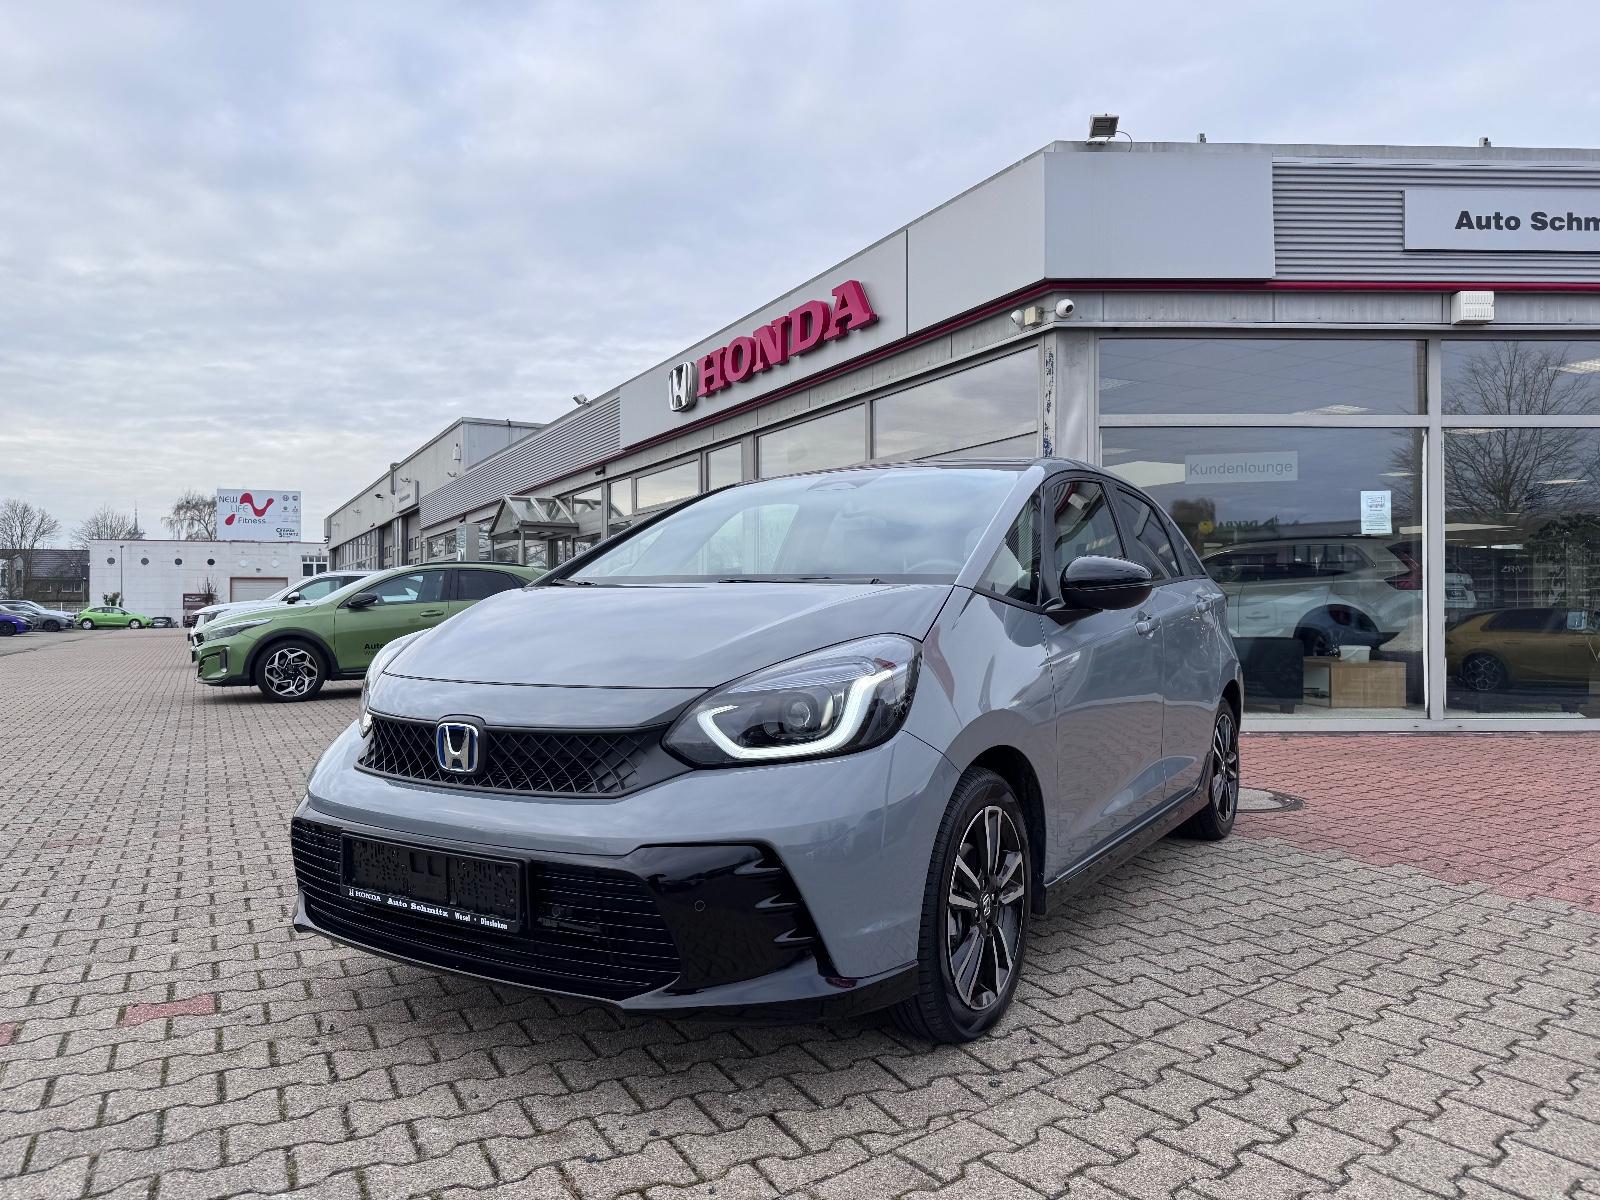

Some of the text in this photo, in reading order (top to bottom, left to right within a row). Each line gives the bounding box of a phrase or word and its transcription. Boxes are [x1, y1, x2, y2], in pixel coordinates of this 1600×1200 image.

[1455, 210, 1521, 231] Auto
[697, 280, 879, 397] HONDA
[1190, 462, 1293, 476] Kundenlounge
[218, 495, 238, 503] NEW
[230, 505, 249, 513] LIFE
[355, 890, 382, 902] HONDA
[387, 897, 408, 908] Auto
[410, 902, 449, 918] Schmitz
[454, 911, 471, 922] Wesel
